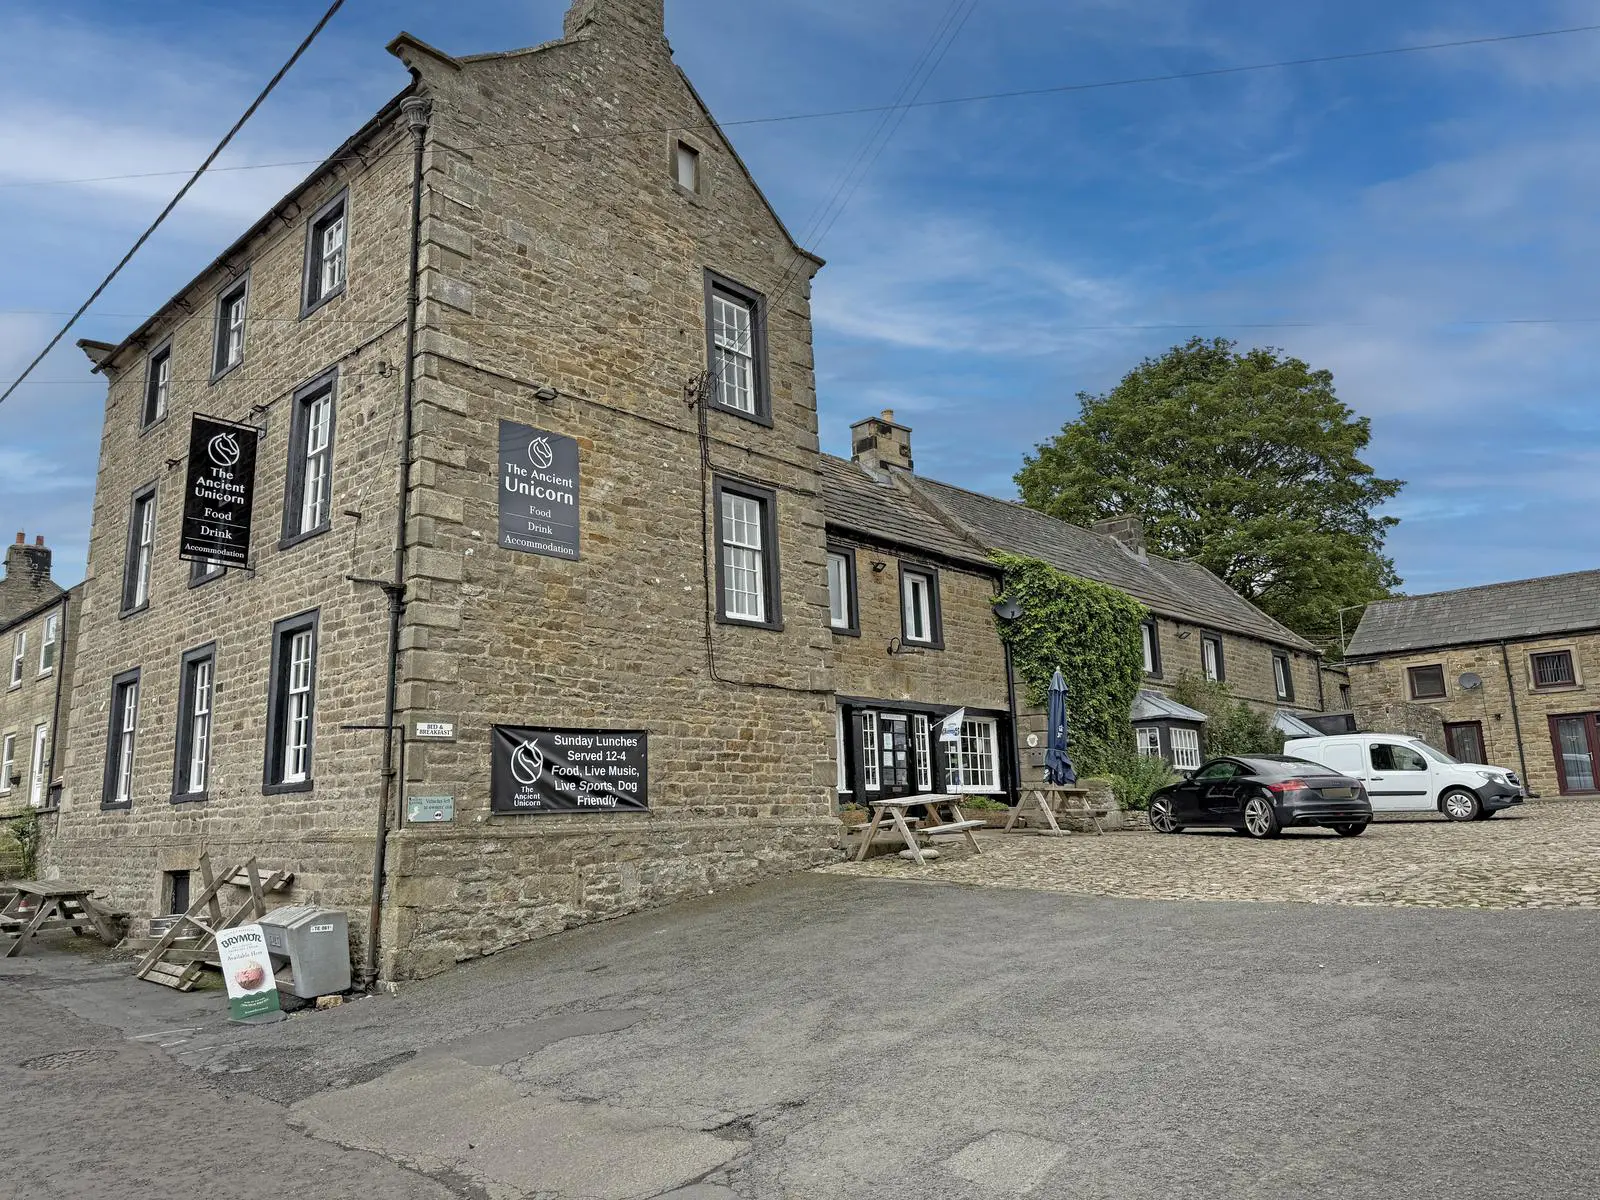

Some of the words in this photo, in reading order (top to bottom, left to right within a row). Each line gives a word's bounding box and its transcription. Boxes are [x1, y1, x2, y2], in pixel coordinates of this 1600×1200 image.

[210, 466, 234, 480] The
[505, 462, 528, 477] The
[531, 469, 573, 489] Ancient
[196, 476, 245, 494] Ancient
[505, 475, 574, 505] Unicorn
[195, 486, 244, 505] Unicorn
[204, 507, 232, 520] Food
[529, 505, 552, 518] Food
[200, 525, 232, 540] Drink
[527, 521, 553, 535] Drink
[184, 543, 245, 559] Accommodation
[504, 534, 574, 555] Accommodation
[554, 734, 594, 748] Sunday
[596, 735, 638, 747] Lunches
[567, 750, 603, 761] Served
[605, 751, 626, 761] 12-4
[551, 765, 583, 777] Food,
[584, 765, 606, 776] Live
[608, 765, 640, 777] Music,
[554, 780, 576, 791] Live
[579, 780, 616, 793] Sports,
[618, 780, 638, 793] Dog
[577, 795, 619, 808] Friendly
[221, 933, 262, 948] BRYMOR
